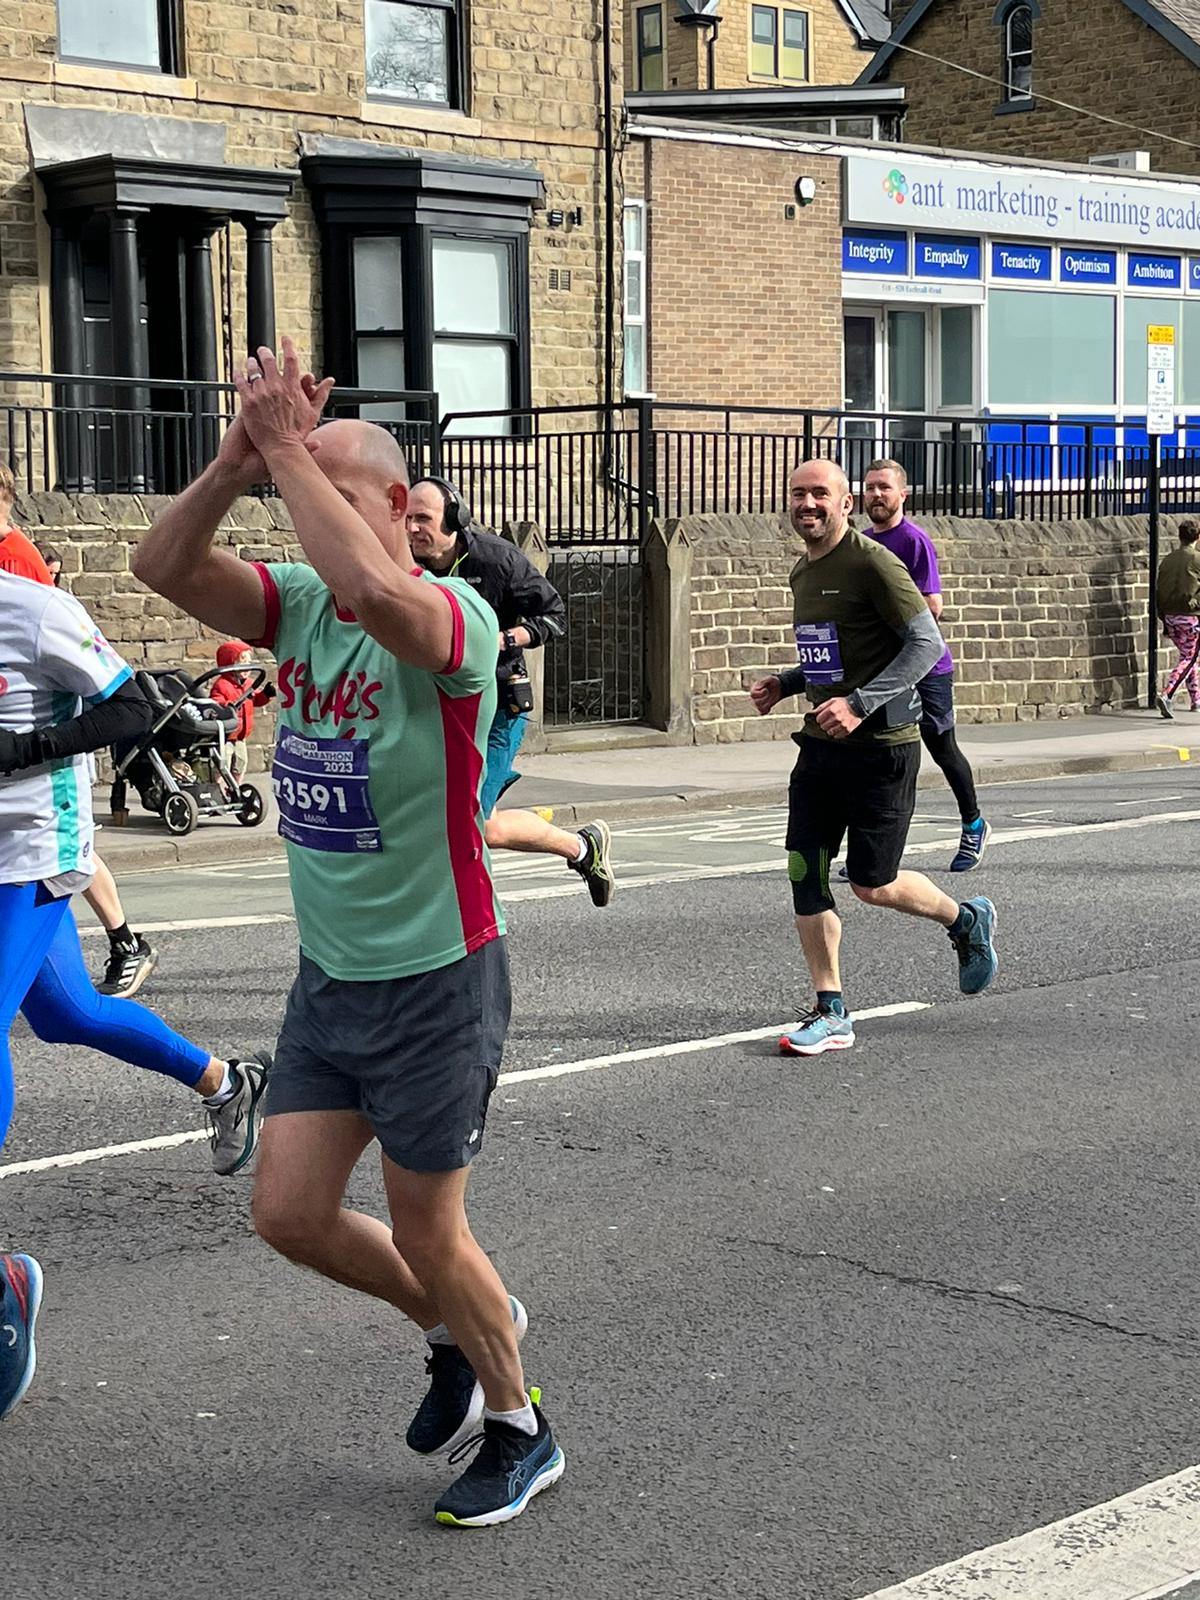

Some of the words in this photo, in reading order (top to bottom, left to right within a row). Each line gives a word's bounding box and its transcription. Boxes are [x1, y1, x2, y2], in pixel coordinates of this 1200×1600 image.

[912, 179, 944, 208] ant
[956, 181, 1058, 228] marketing
[1078, 190, 1151, 235] training
[848, 241, 895, 264] Integrity
[923, 246, 970, 269] Empathy
[1000, 252, 1041, 274] Tenacity
[1064, 256, 1111, 276] Optimism
[1133, 263, 1174, 280] Ambition
[800, 646, 831, 663] 5134
[303, 750, 352, 761] MARATHON
[323, 761, 353, 774] 2023
[303, 812, 329, 826] MARK
